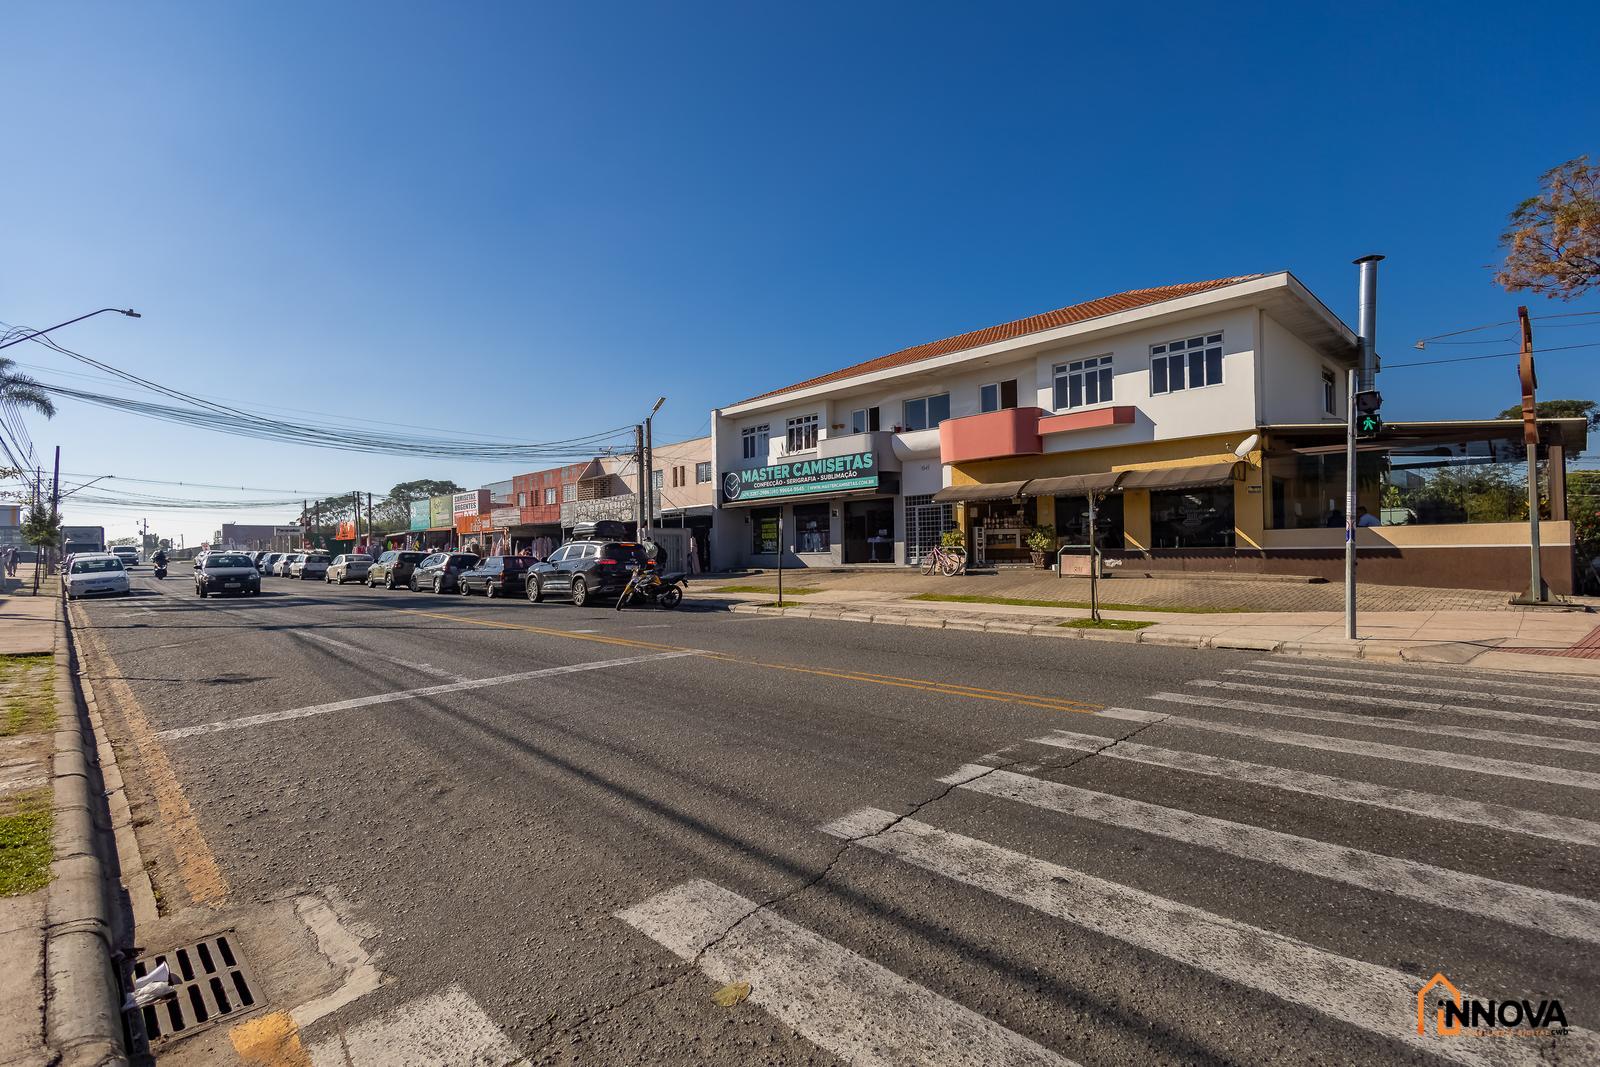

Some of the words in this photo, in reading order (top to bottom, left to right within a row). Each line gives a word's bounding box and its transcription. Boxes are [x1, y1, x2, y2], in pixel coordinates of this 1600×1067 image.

[742, 465, 789, 483] MASTER
[793, 453, 873, 476] CAMISETAS
[754, 479, 783, 488] CONFECÇÃO
[787, 476, 816, 485] SERIGRAFIA
[820, 470, 858, 481] SUBLIMAÇÃO
